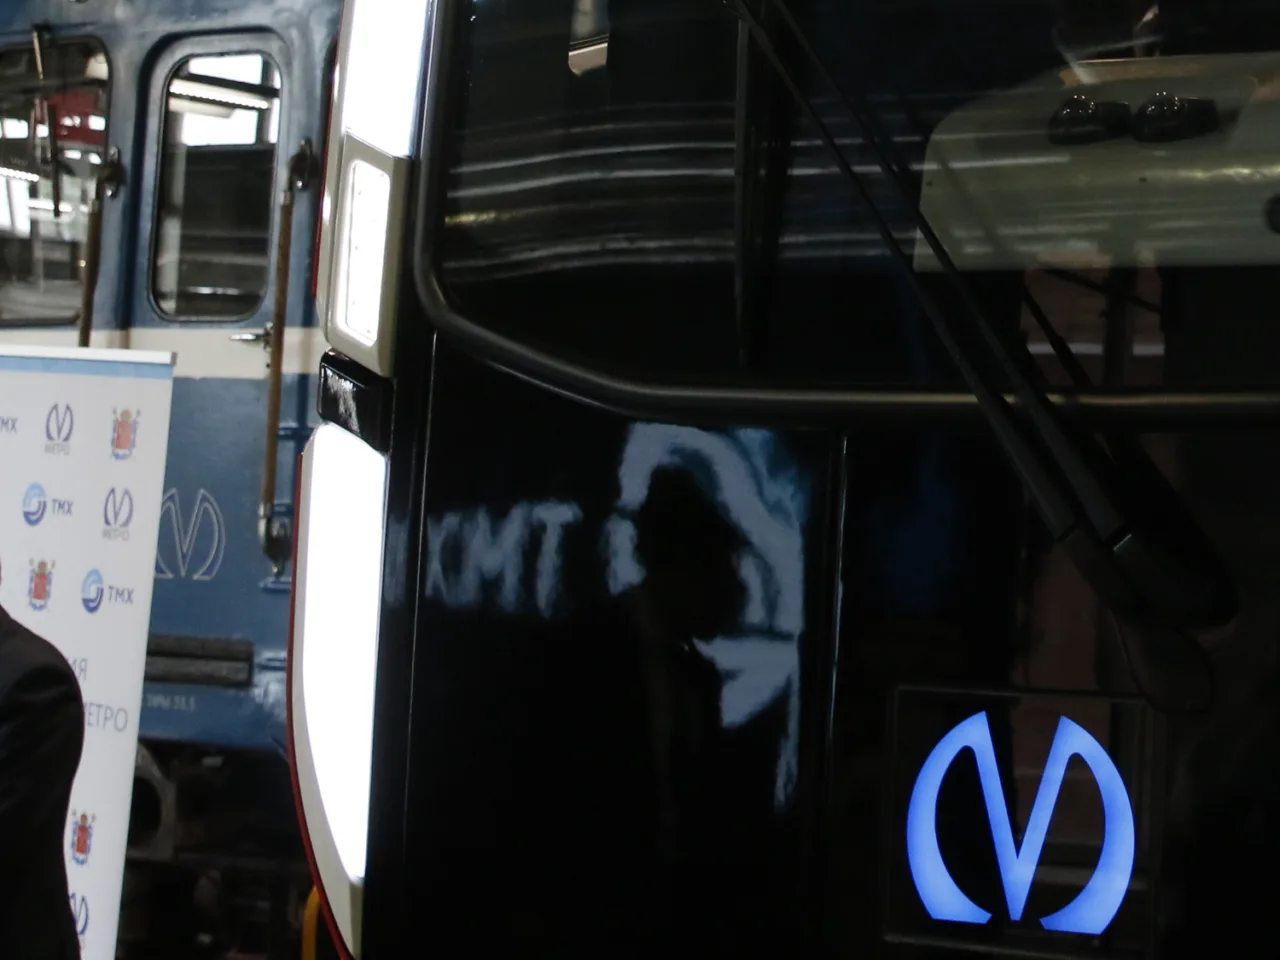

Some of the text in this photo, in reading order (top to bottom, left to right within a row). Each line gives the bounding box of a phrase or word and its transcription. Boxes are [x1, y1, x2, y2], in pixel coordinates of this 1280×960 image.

[0, 416, 18, 433] МХ
[52, 499, 74, 517] ТМХ
[107, 585, 135, 604] ТМХ
[83, 701, 129, 733] ЕТРО
